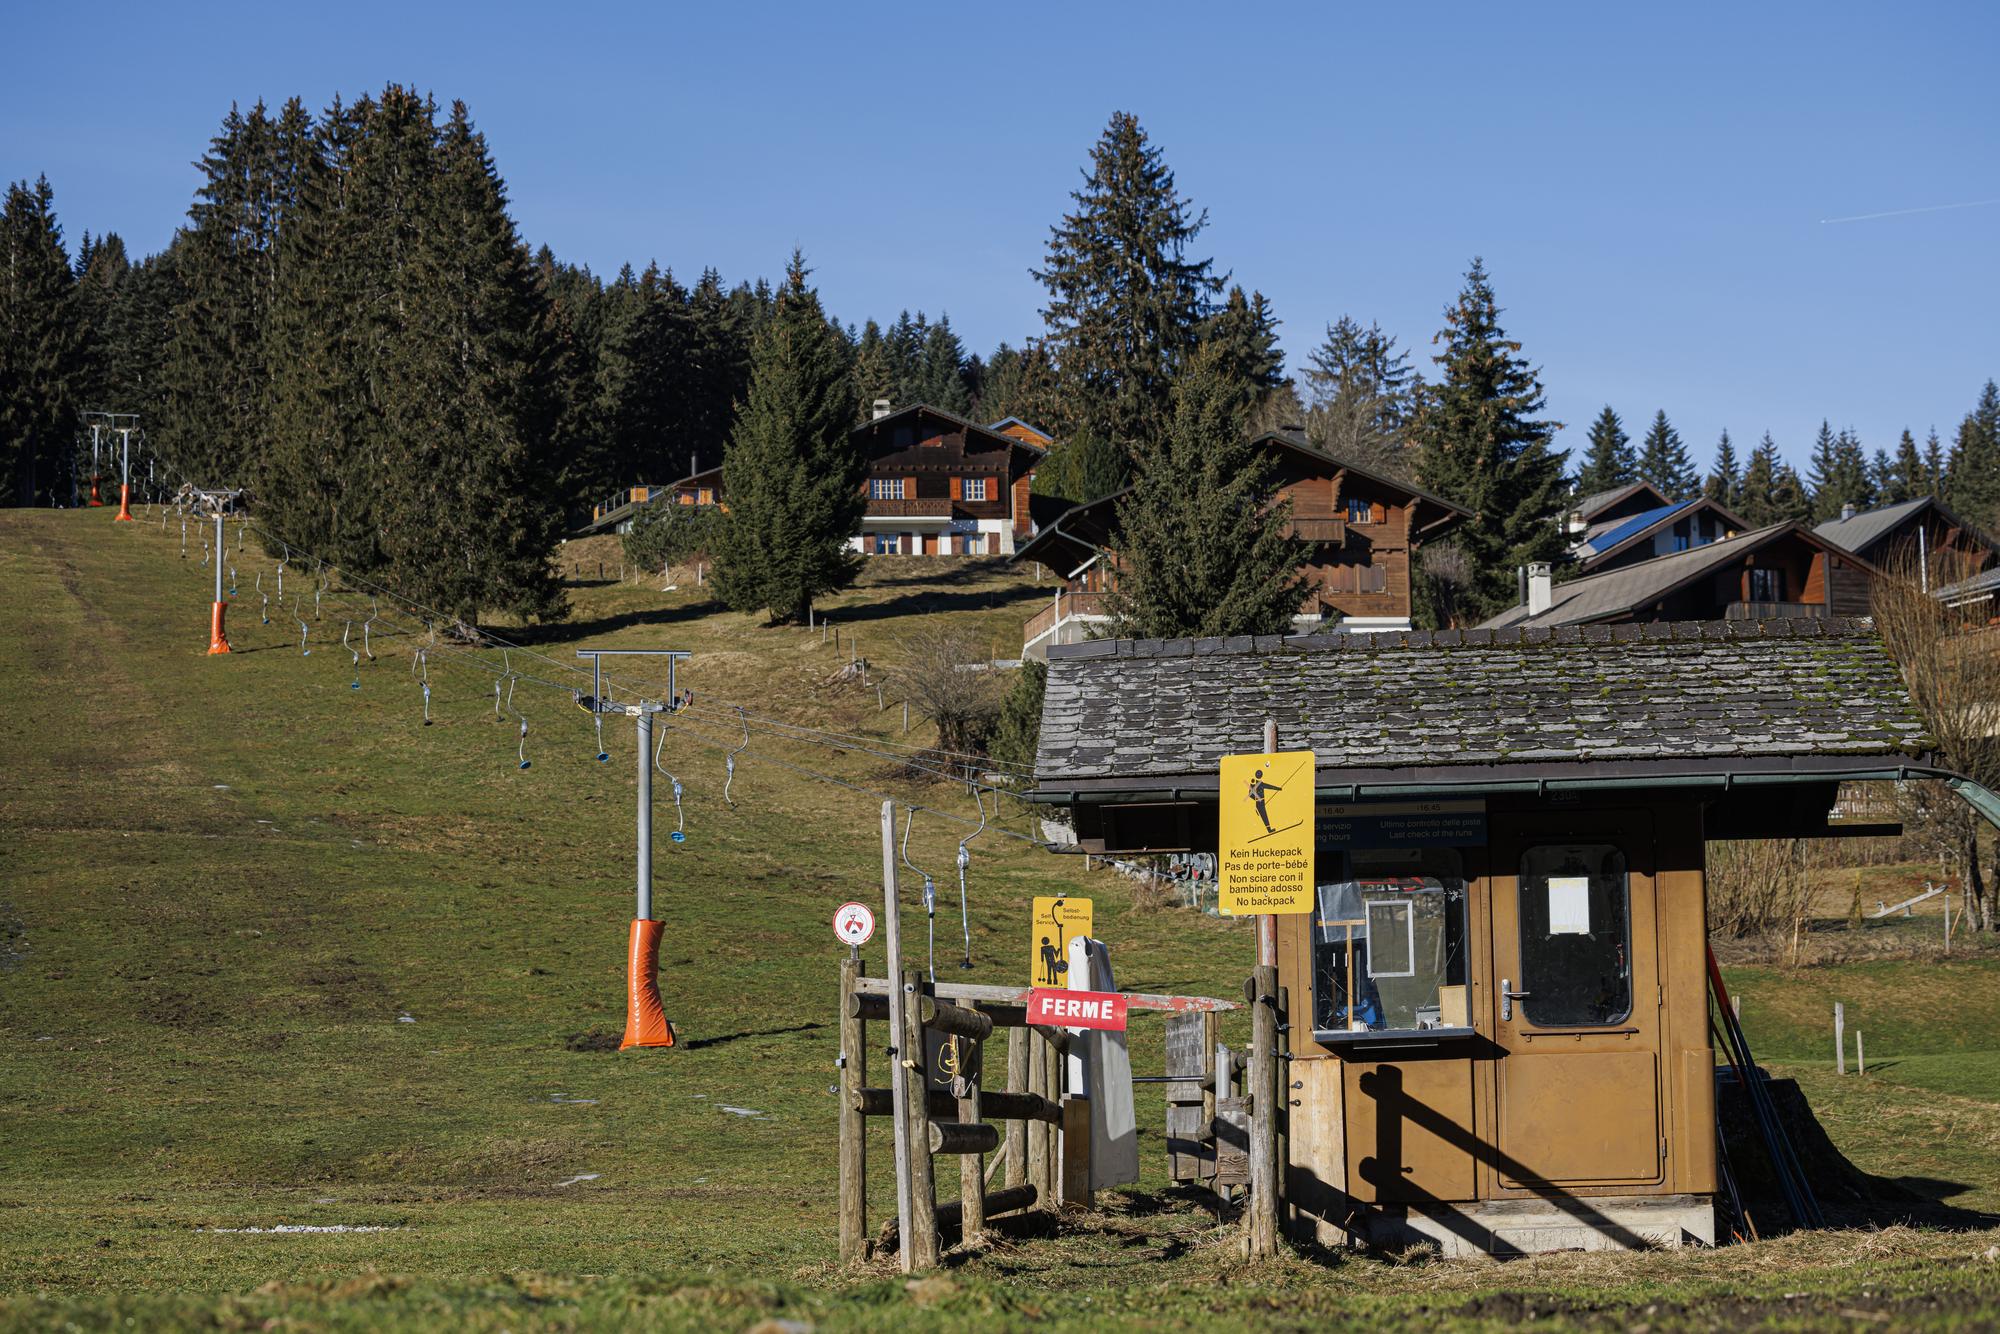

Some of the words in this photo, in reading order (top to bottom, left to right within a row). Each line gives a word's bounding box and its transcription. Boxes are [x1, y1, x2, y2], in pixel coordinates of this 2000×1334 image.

[1380, 820, 1405, 829] Ultimo
[1407, 819, 1441, 828] controllo
[1441, 818, 1461, 827] delle
[1329, 833, 1351, 841] hours
[1389, 831, 1406, 839] Last
[1407, 829, 1431, 838] check
[1432, 829, 1440, 837] of
[1441, 829, 1453, 837] the
[1455, 829, 1472, 837] runs
[1230, 849, 1250, 858] Kein
[1252, 847, 1302, 858] Huckepack
[1224, 862, 1241, 871] Pas
[1243, 861, 1254, 870] de
[1256, 859, 1308, 872] porte-bébé
[1229, 874, 1247, 884] Non
[1249, 873, 1277, 883] sciare
[1279, 874, 1296, 882] con
[1298, 872, 1303, 881] il
[1229, 884, 1268, 894] bambino
[1270, 884, 1303, 892] adosso
[1236, 897, 1249, 906] No
[1251, 896, 1295, 907] backpack
[1041, 997, 1114, 1020] FERMÉ
